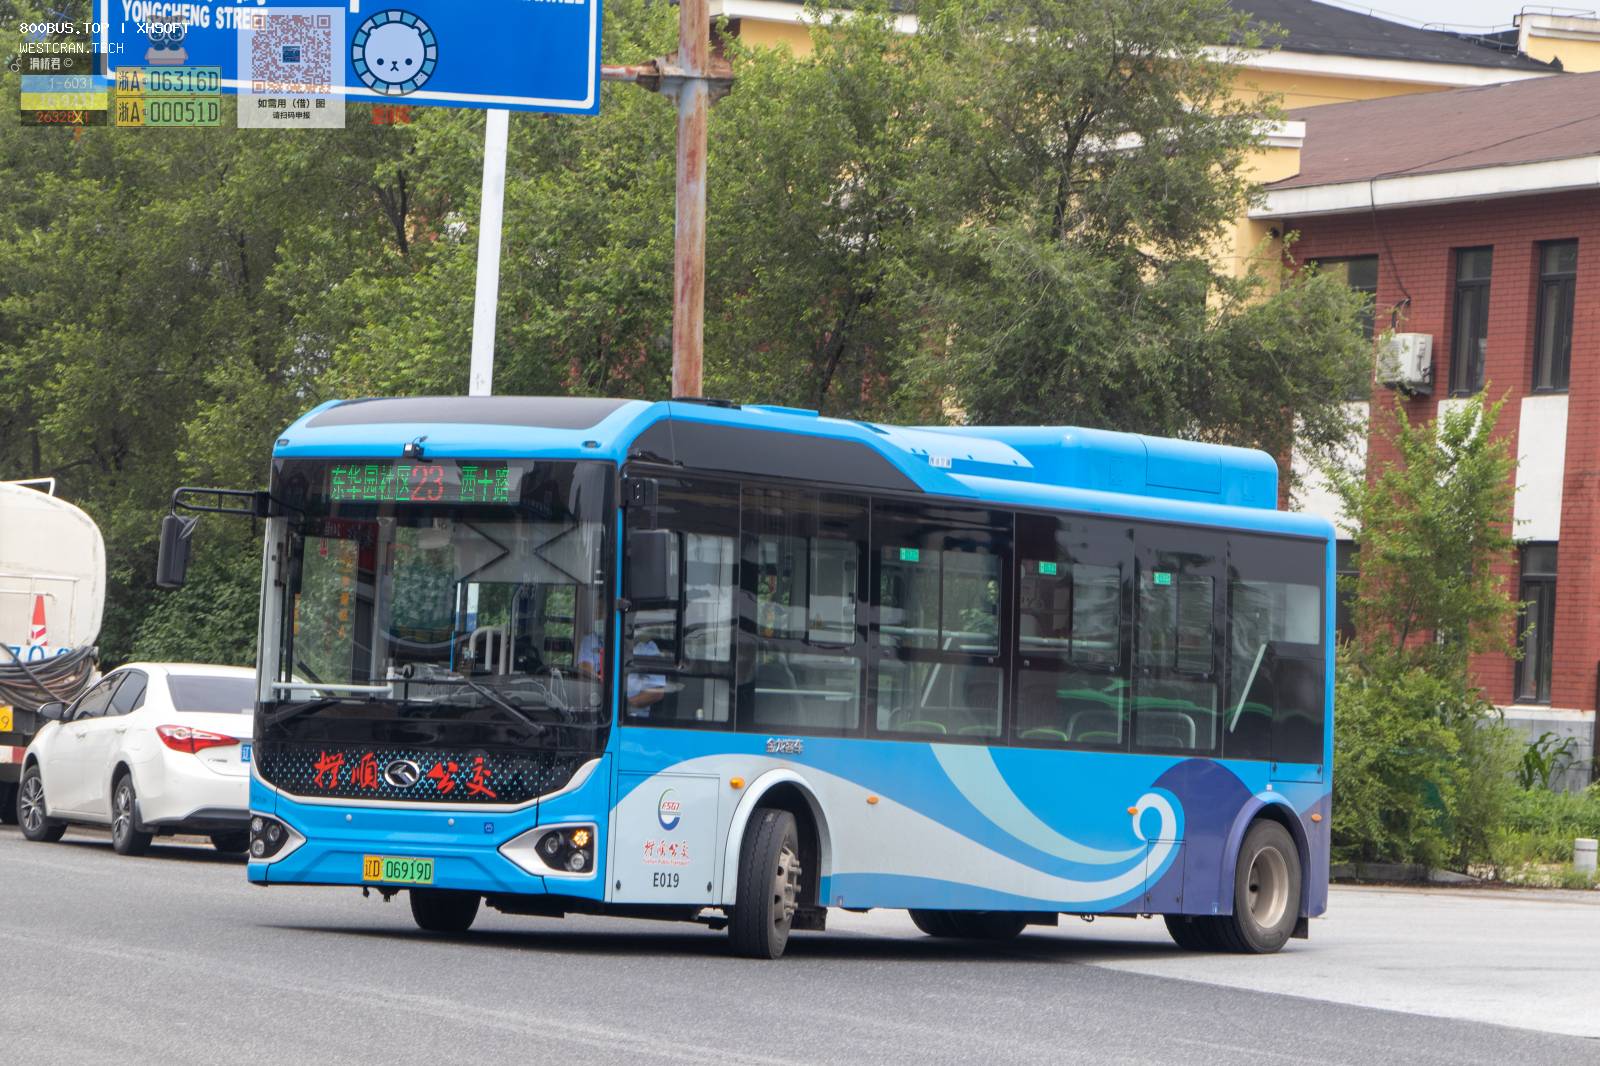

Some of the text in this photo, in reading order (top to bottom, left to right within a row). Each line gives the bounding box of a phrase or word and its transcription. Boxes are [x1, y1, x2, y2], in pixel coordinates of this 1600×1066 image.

[122, 0, 210, 28] YONGCHENG
[411, 465, 445, 501] 23
[427, 757, 497, 799] 公交
[386, 860, 432, 881] 06919D
[653, 872, 680, 888] E019
